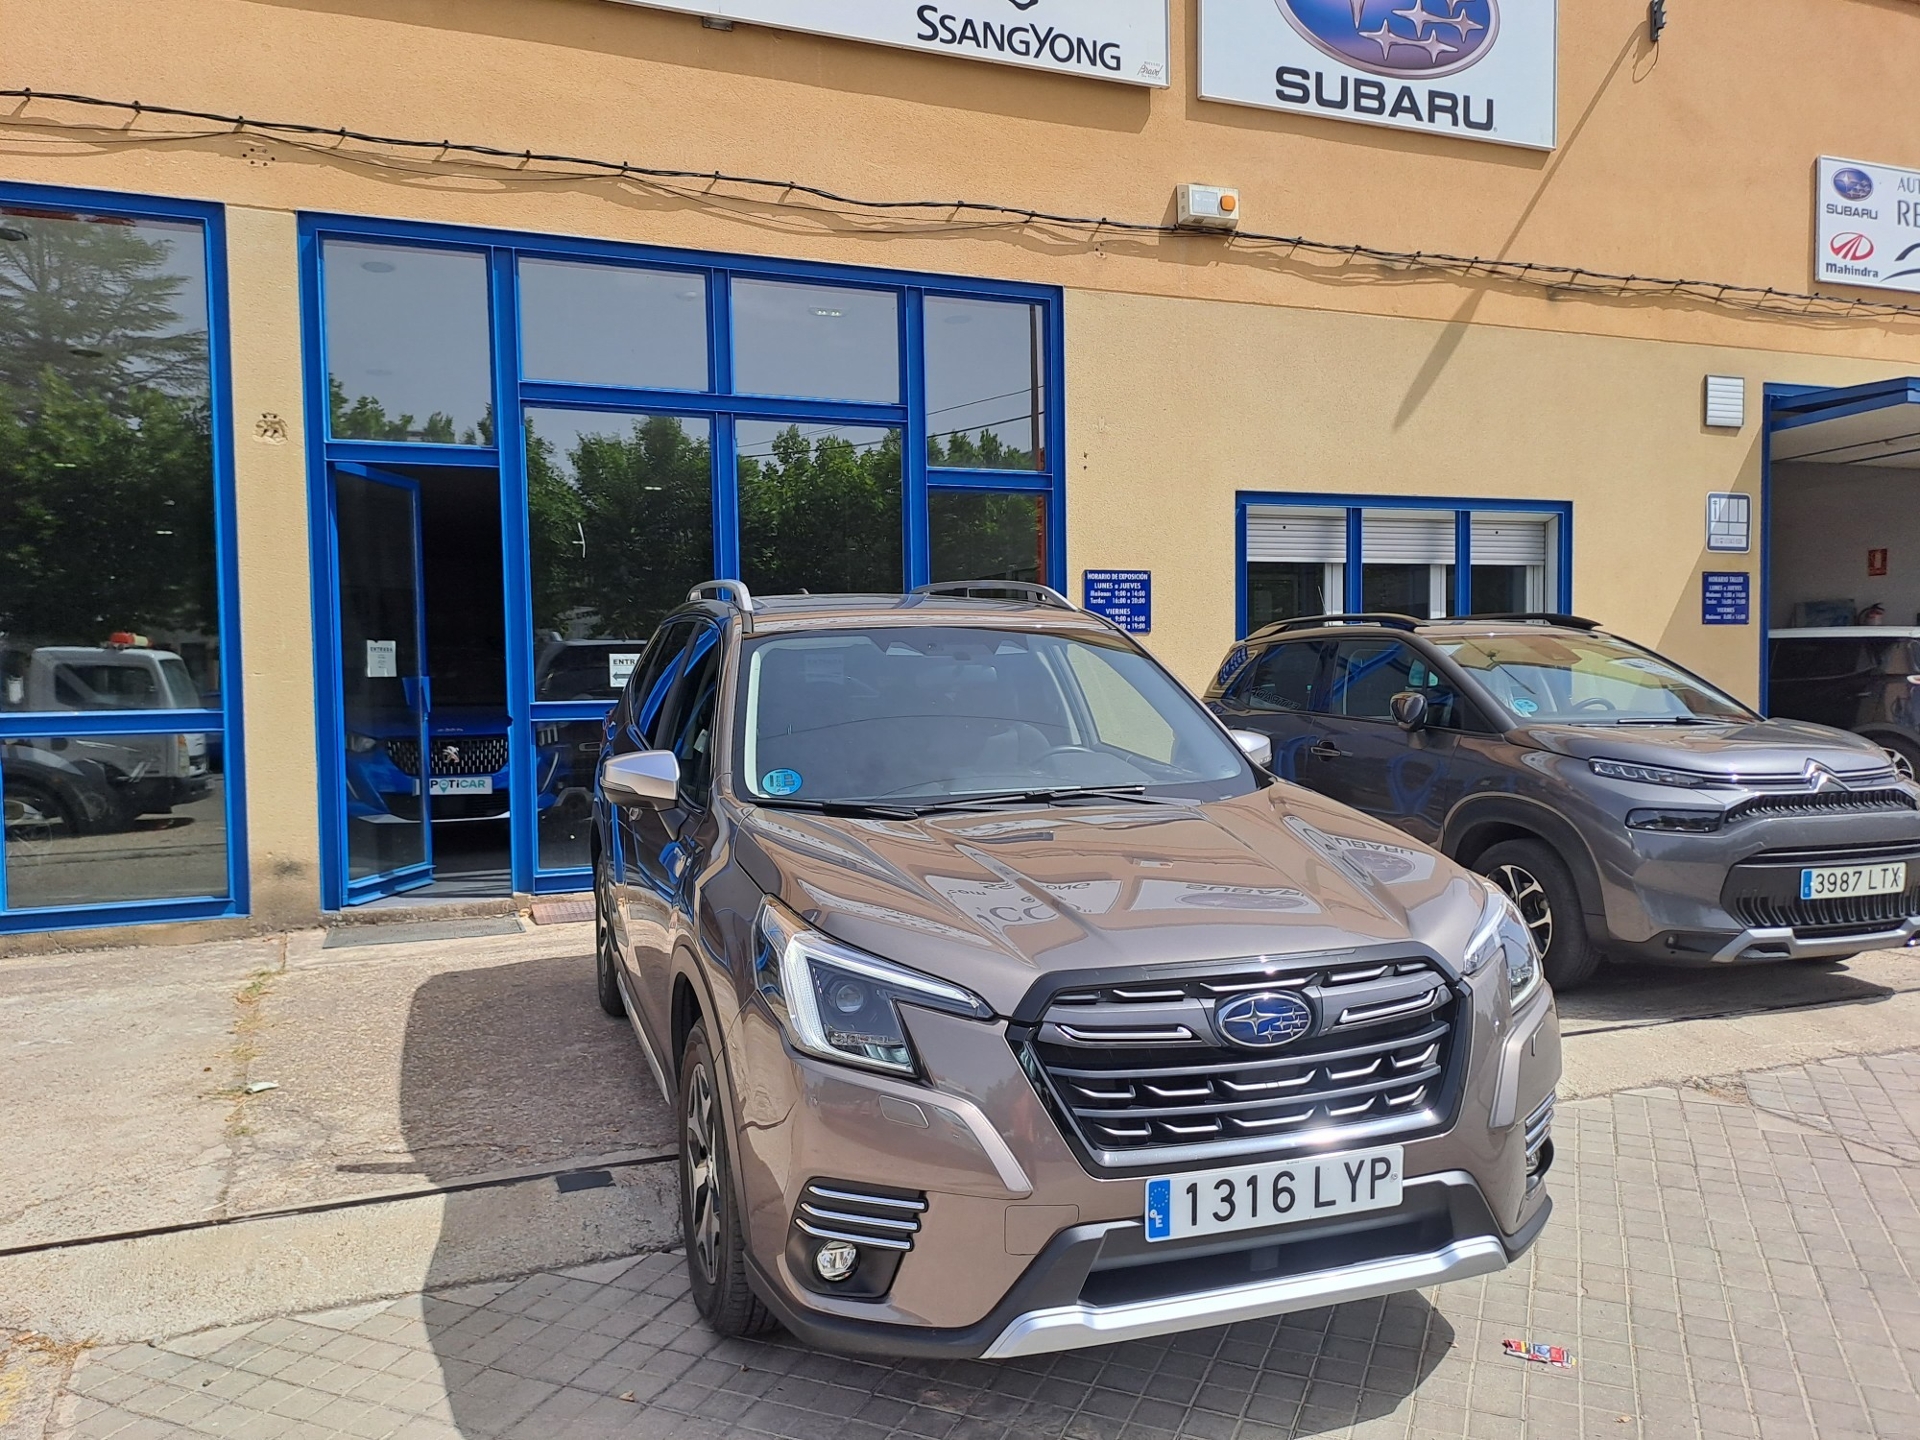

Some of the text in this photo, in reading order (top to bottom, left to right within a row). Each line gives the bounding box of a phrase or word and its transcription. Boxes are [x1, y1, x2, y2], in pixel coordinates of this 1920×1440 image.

[917, 4, 1121, 71] SSANGYONG
[1275, 65, 1494, 132] SUBARU
[1826, 203, 1878, 220] SUBARU
[1815, 870, 1862, 894] 3987
[1868, 867, 1900, 890] LTX
[1154, 1156, 1392, 1228] E 1316 LYP
